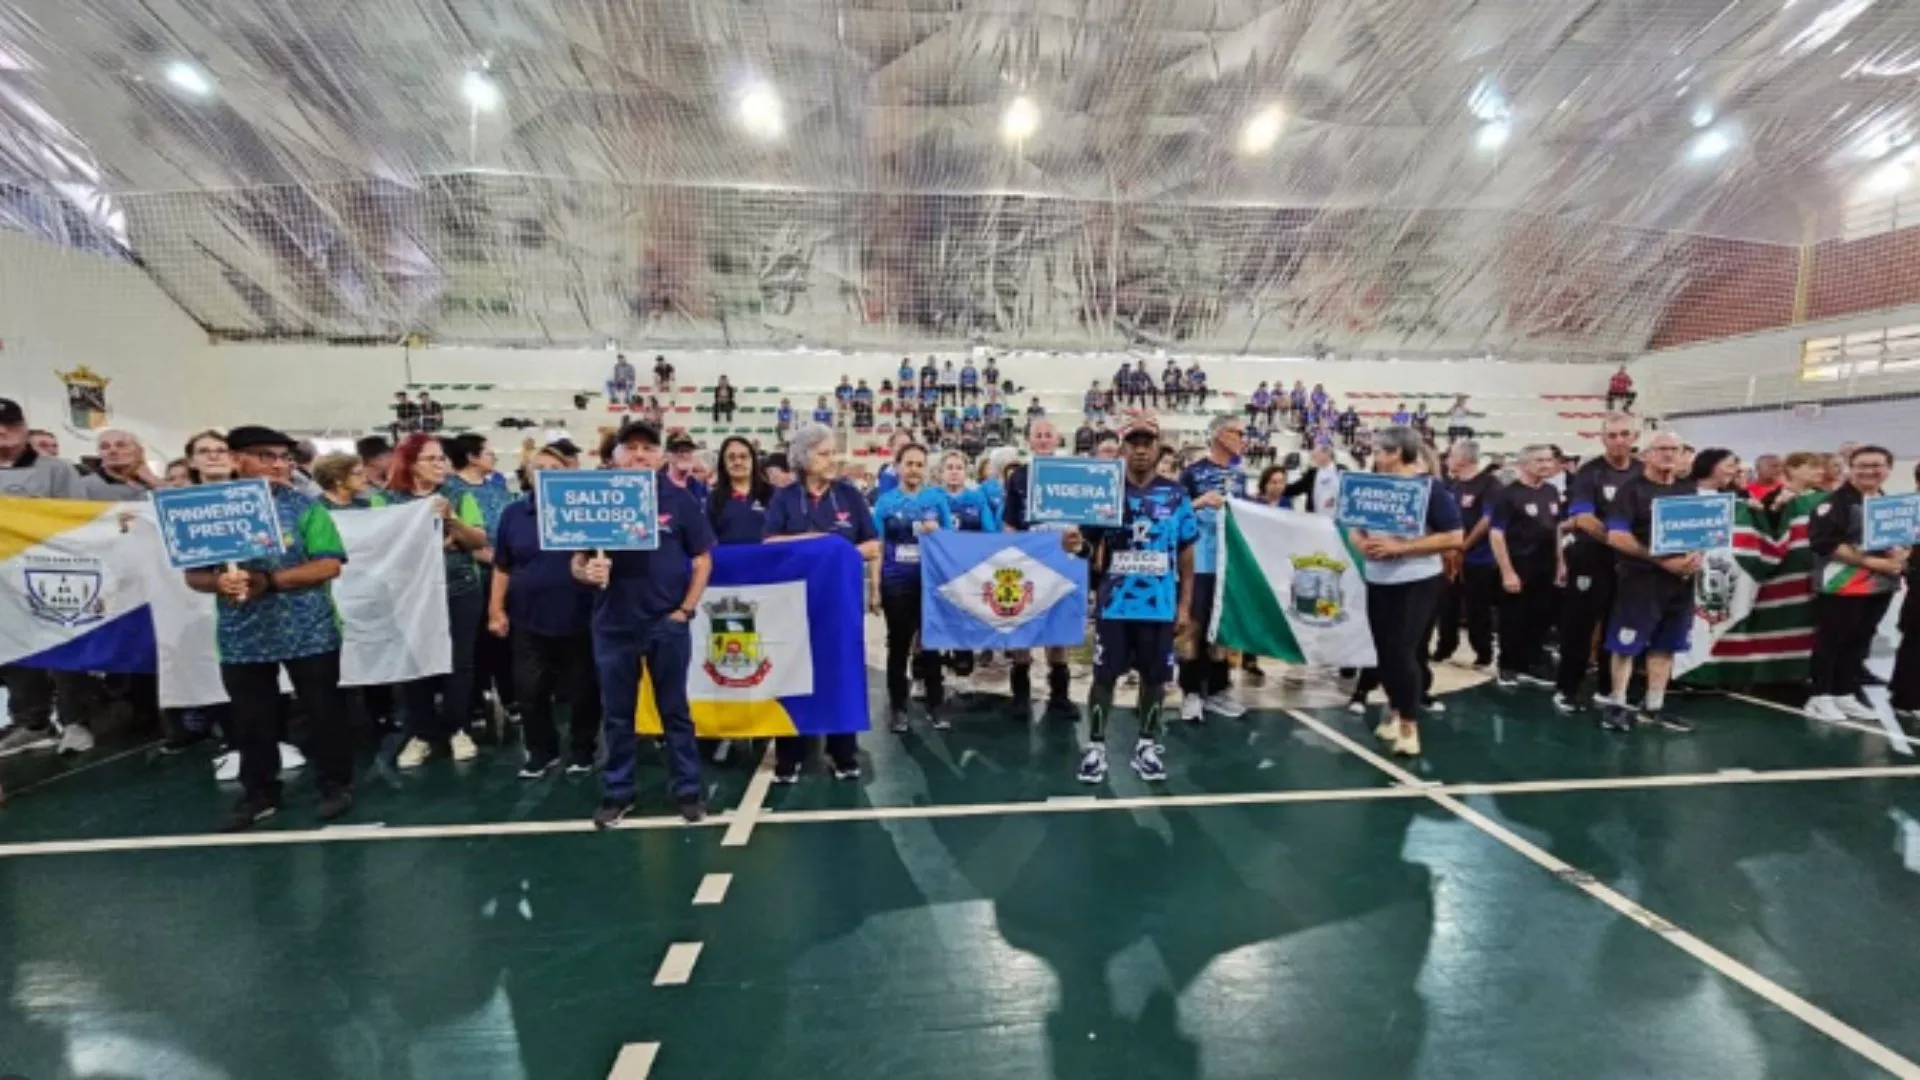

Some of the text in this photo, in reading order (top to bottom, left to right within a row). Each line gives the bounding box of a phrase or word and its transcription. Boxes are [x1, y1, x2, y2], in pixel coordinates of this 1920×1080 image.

[564, 489, 625, 505] SALTO
[1046, 483, 1106, 498] VIDEIRA
[167, 500, 255, 521] PINHEIRO
[560, 506, 638, 522] VELOSO
[187, 518, 252, 539] PRETO
